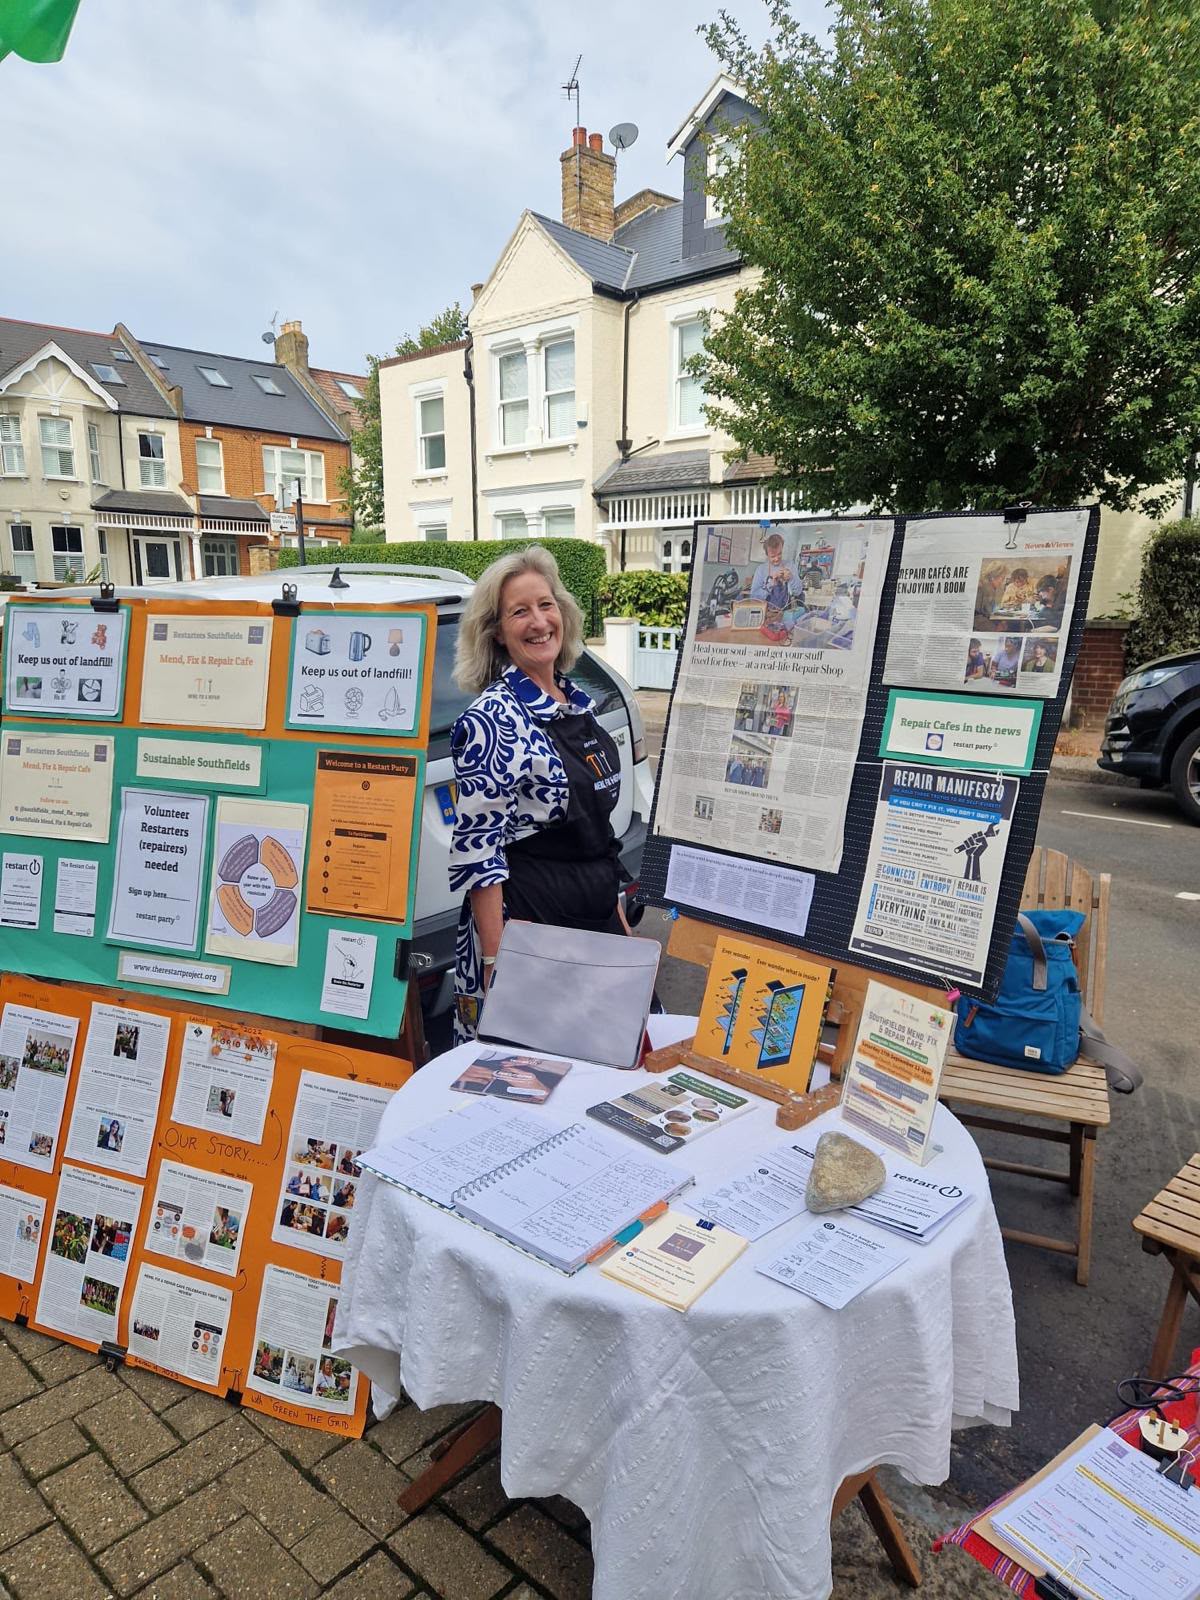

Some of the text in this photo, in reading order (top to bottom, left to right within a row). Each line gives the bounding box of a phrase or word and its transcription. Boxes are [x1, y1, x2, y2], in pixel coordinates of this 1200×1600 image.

[899, 565, 969, 579] REPAIR CAFÉS ARE
[897, 581, 966, 594] ENJOYING A BOOM
[207, 632, 243, 640] Southfields
[18, 654, 38, 666] Keep
[52, 657, 66, 666] out
[68, 656, 79, 666] of
[80, 656, 113, 667] landfill!
[693, 645, 824, 661] Heal your soul and get your stuff
[160, 655, 254, 667] Mend, Fix & Repair Cafe
[710, 657, 722, 666] for
[723, 658, 738, 668] free
[760, 661, 790, 672] real-life
[792, 663, 820, 675] Repair
[821, 664, 844, 677] Shop
[301, 666, 325, 678] Keep
[342, 669, 358, 678] out
[361, 667, 372, 678] of
[374, 668, 412, 680] landfill!
[900, 718, 1022, 736] Repair Cafes in the news
[26, 747, 55, 756] Restarters
[953, 741, 992, 751] restart party
[58, 764, 77, 773] Repair
[143, 753, 250, 771] Sustainable Southfields
[325, 759, 353, 768] Welcome
[367, 763, 390, 771] Restart
[391, 765, 409, 773] Party
[893, 769, 1005, 801] REPAIR MANIFESTO
[144, 805, 190, 820] Volunteer
[140, 822, 189, 837] Restarters
[139, 839, 188, 856] (repairers)
[5, 862, 28, 870] restart
[144, 859, 178, 872] needed
[882, 864, 916, 880] CONNECTS
[128, 887, 142, 896] Sign
[920, 879, 950, 894] ENTROPY
[958, 880, 986, 895] REPAIR IS
[875, 898, 926, 921] EVERYTHING
[938, 898, 956, 909] CHOOSE
[136, 912, 175, 925] restart party
[930, 918, 940, 926] ANY
[947, 922, 956, 931] ALL
[756, 959, 767, 967] Ever
[768, 963, 785, 972] wonder
[786, 967, 797, 975] what
[803, 972, 820, 982] inside?
[869, 1011, 906, 1032] SOUTHFIELDS
[927, 1035, 938, 1046] FIX
[884, 1027, 905, 1042] REPAIR
[906, 1037, 923, 1050] CAFE
[220, 1038, 269, 1057] GRID NEWS
[165, 1128, 197, 1150] OUR
[893, 1173, 939, 1190] restart
[305, 1413, 322, 1423] THE
